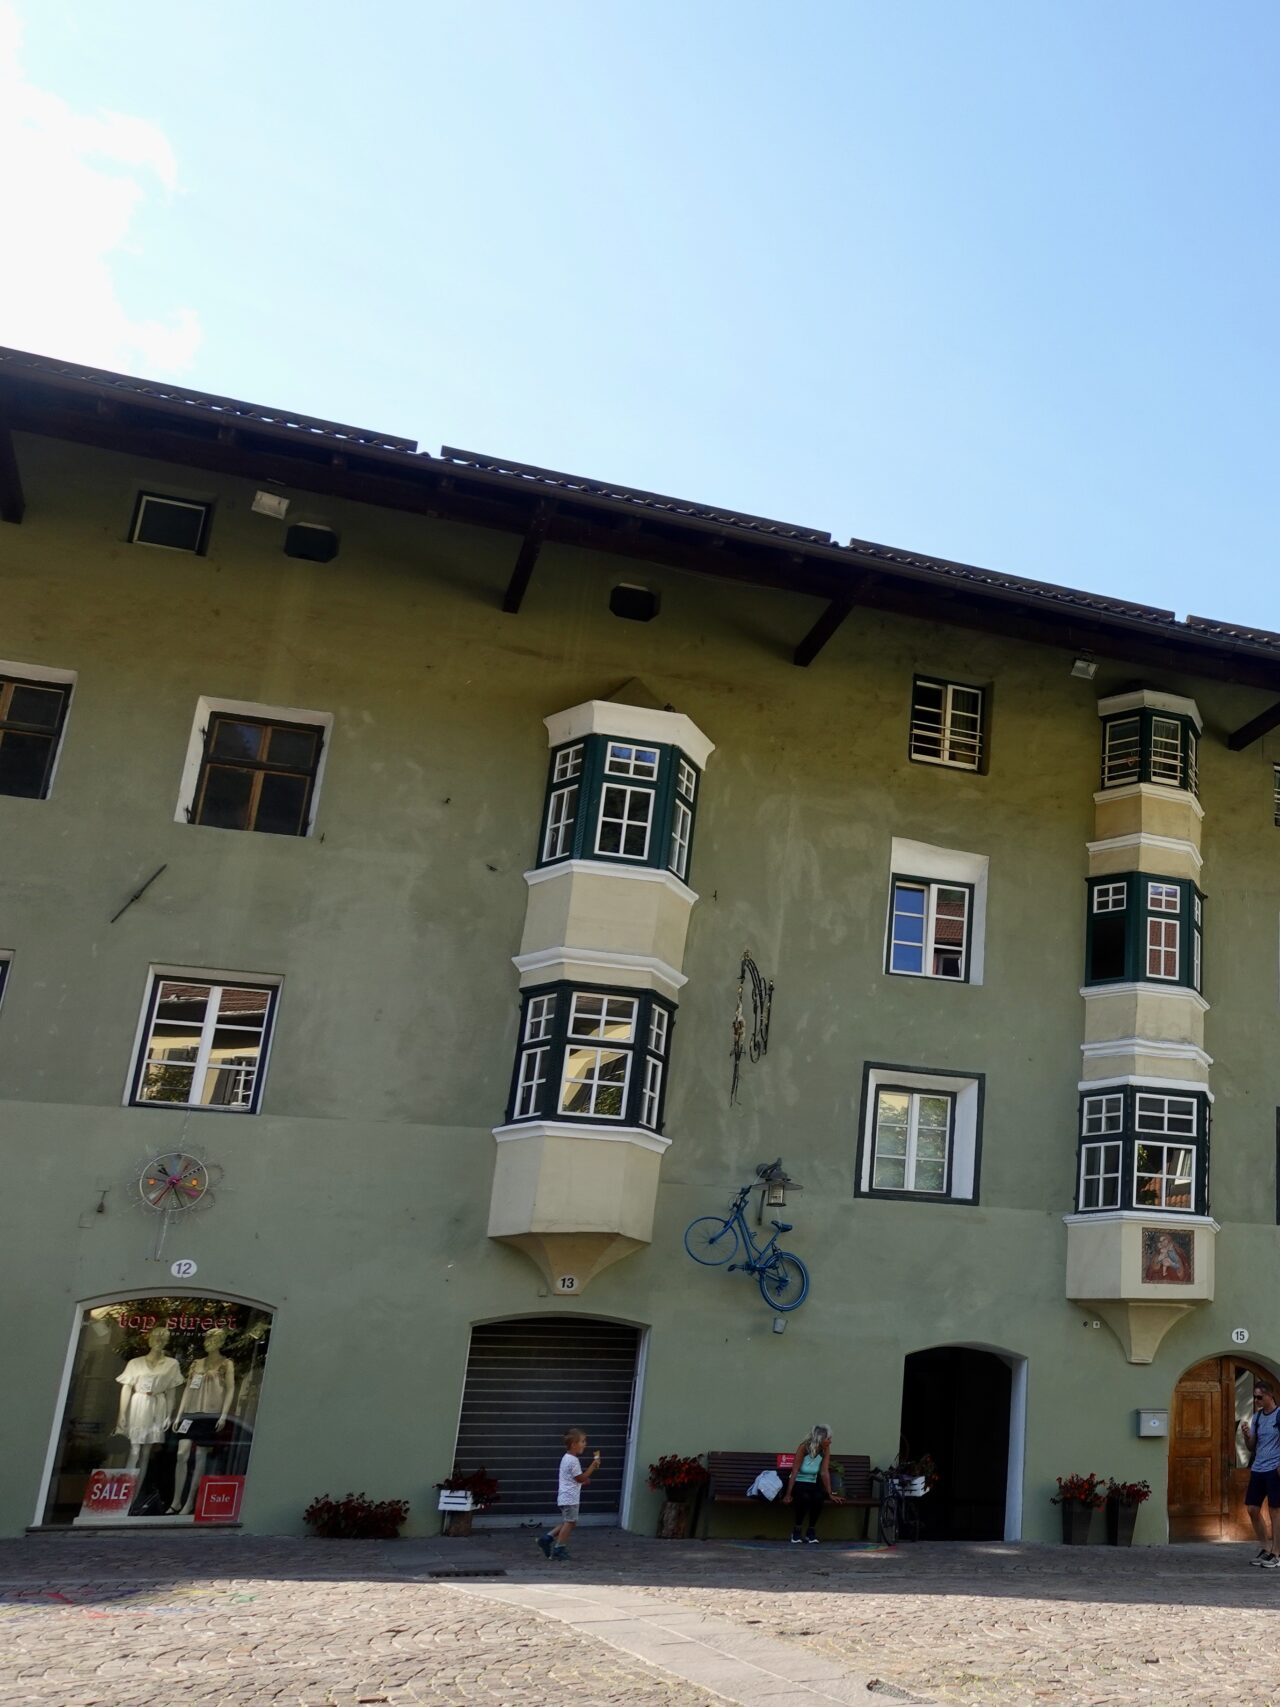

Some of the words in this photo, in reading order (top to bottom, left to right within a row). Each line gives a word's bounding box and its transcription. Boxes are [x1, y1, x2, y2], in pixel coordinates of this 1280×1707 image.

[176, 1262, 192, 1275] 12
[560, 1277, 575, 1289] 13
[118, 1312, 156, 1332] top
[165, 1311, 237, 1330] street
[1235, 1330, 1246, 1341] 15
[91, 1483, 131, 1500] SALE
[210, 1494, 231, 1503] Sale
